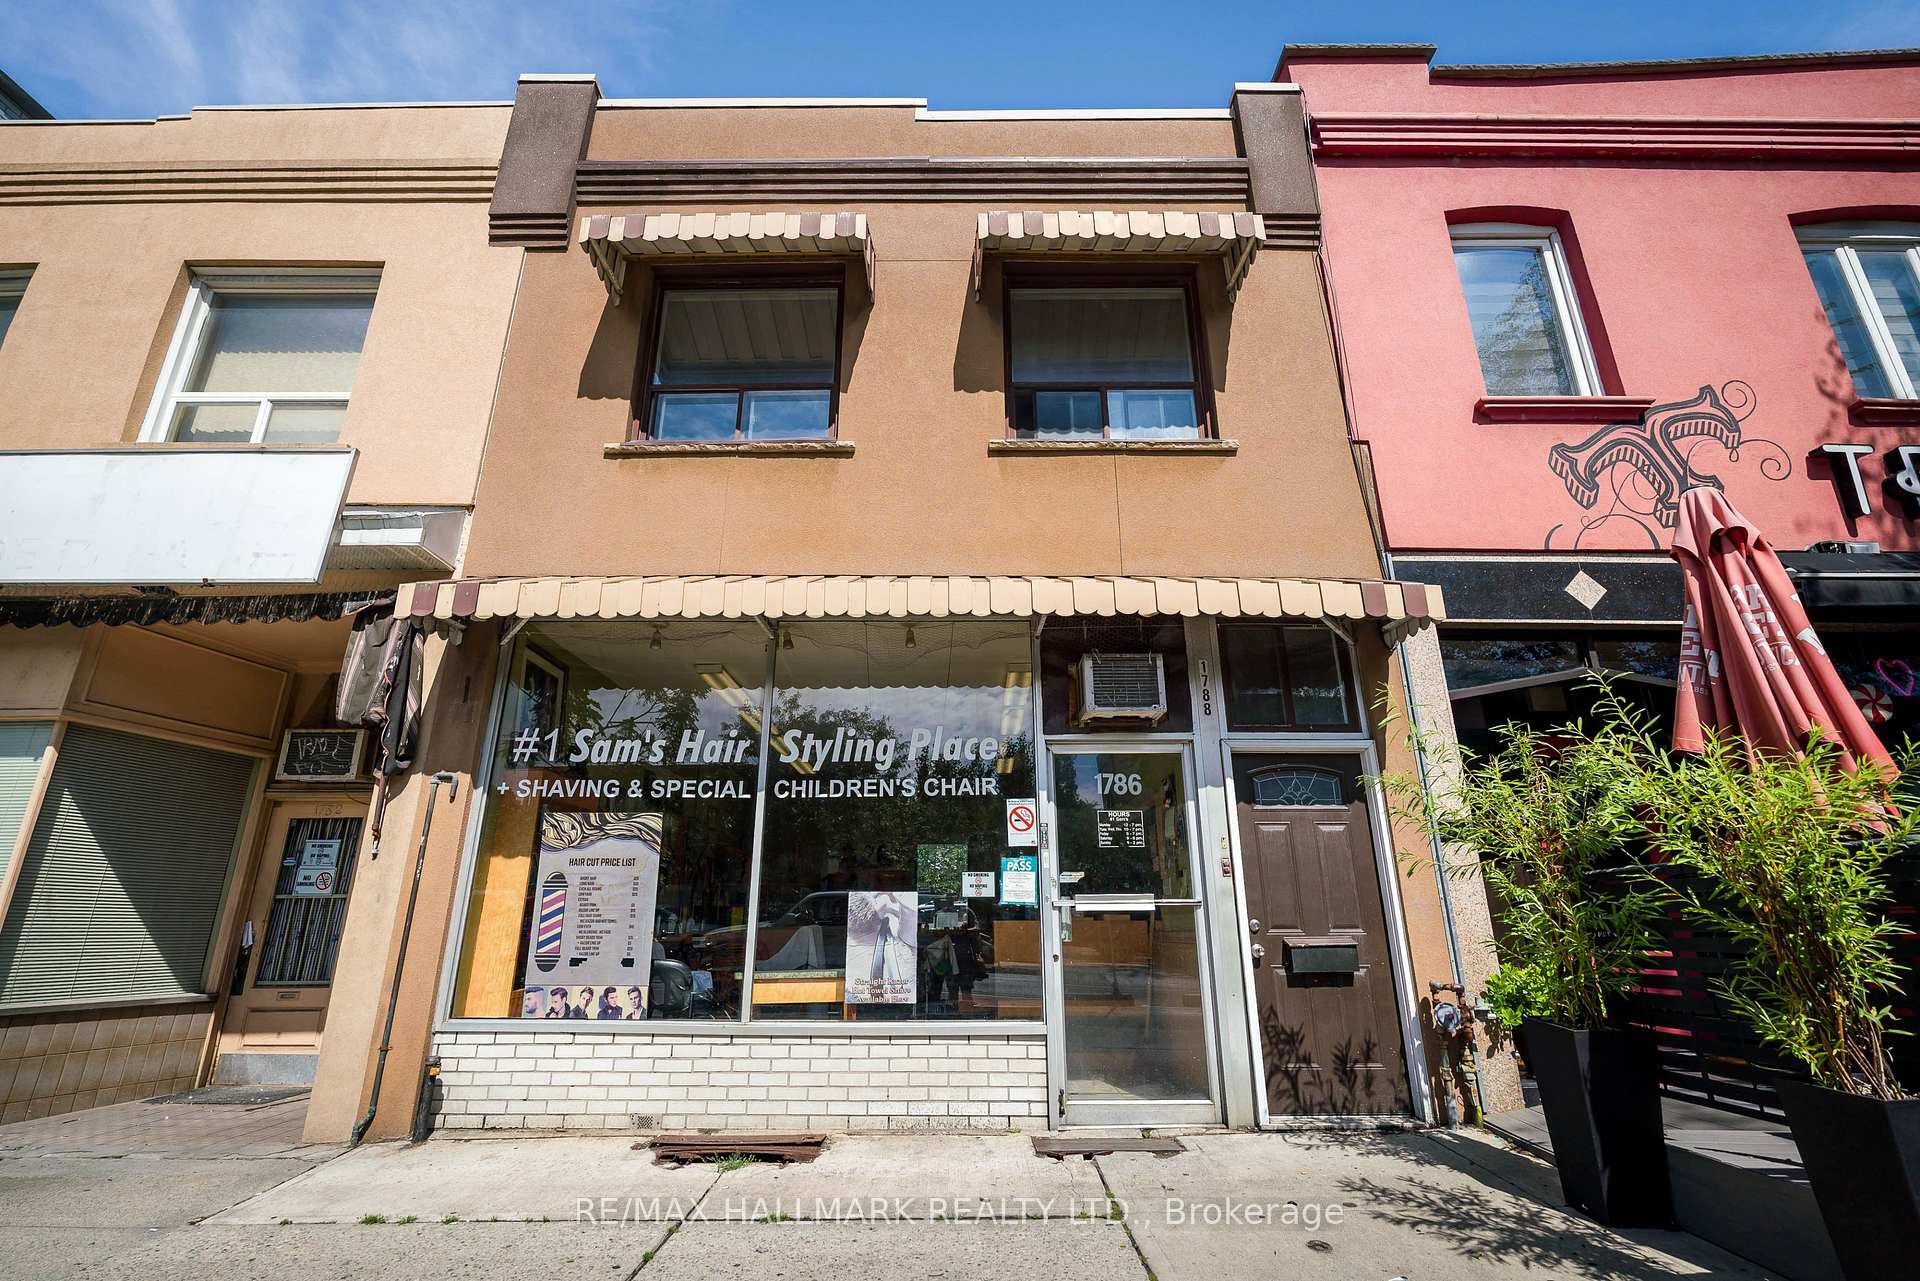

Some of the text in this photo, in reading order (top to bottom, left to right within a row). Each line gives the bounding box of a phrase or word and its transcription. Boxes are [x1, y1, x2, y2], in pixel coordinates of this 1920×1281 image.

[1201, 660, 1211, 716] 1788
[512, 726, 1000, 772] #1 Sam's Hair Styling Place
[516, 780, 620, 798] SHAVING
[627, 780, 643, 798] &
[650, 780, 750, 799] SPECIAL
[774, 779, 916, 798] CHILDREN'S
[924, 778, 998, 796] CHAIR
[1094, 773, 1142, 795] 1786
[568, 858, 636, 866] HAIR CUT PRICE LIST
[1007, 861, 1032, 871] PASS
